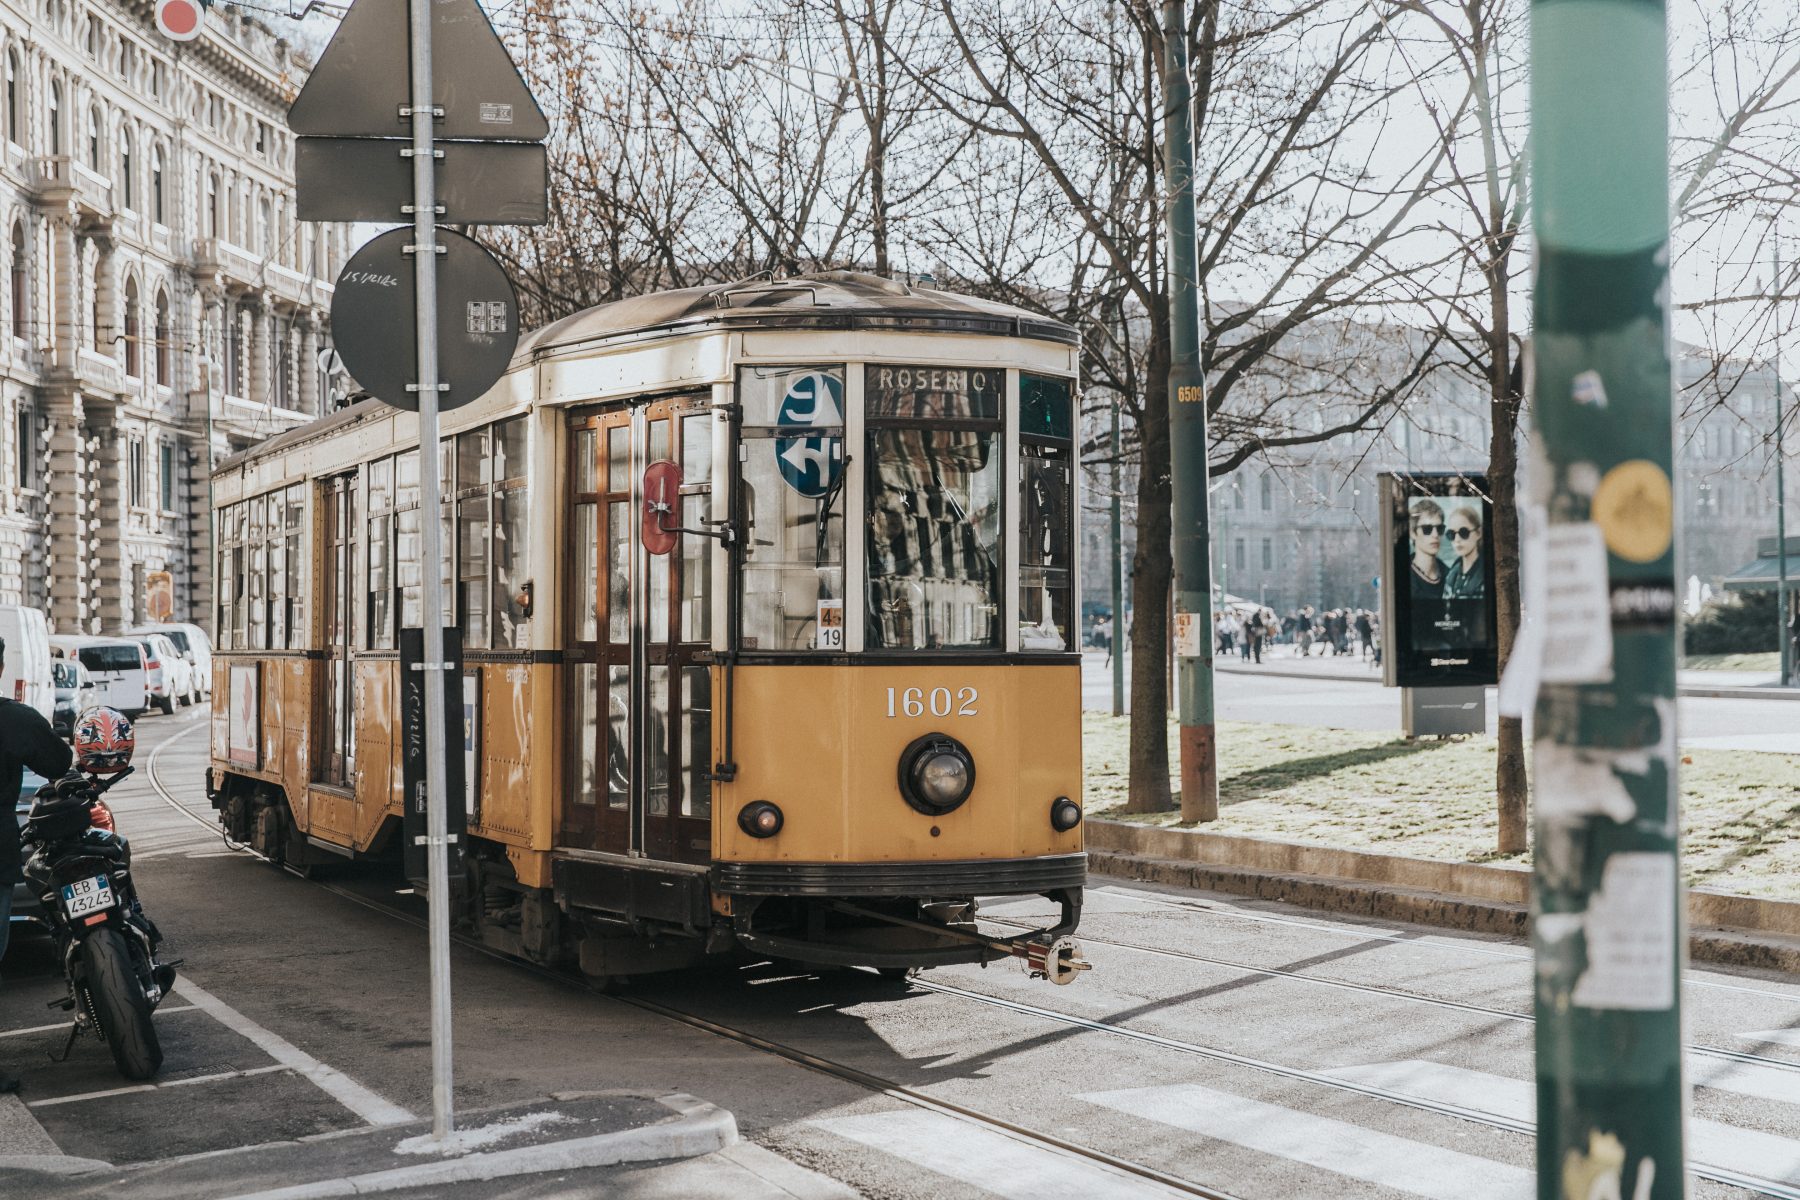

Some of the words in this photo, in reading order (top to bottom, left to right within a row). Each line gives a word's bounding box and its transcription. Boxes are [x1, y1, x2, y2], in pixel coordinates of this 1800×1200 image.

[880, 368, 986, 391] ROSERIO
[1178, 386, 1203, 402] 6509
[823, 629, 841, 646] 19
[886, 687, 979, 718] 1602
[73, 881, 91, 896] EB
[72, 891, 111, 913] 43243
